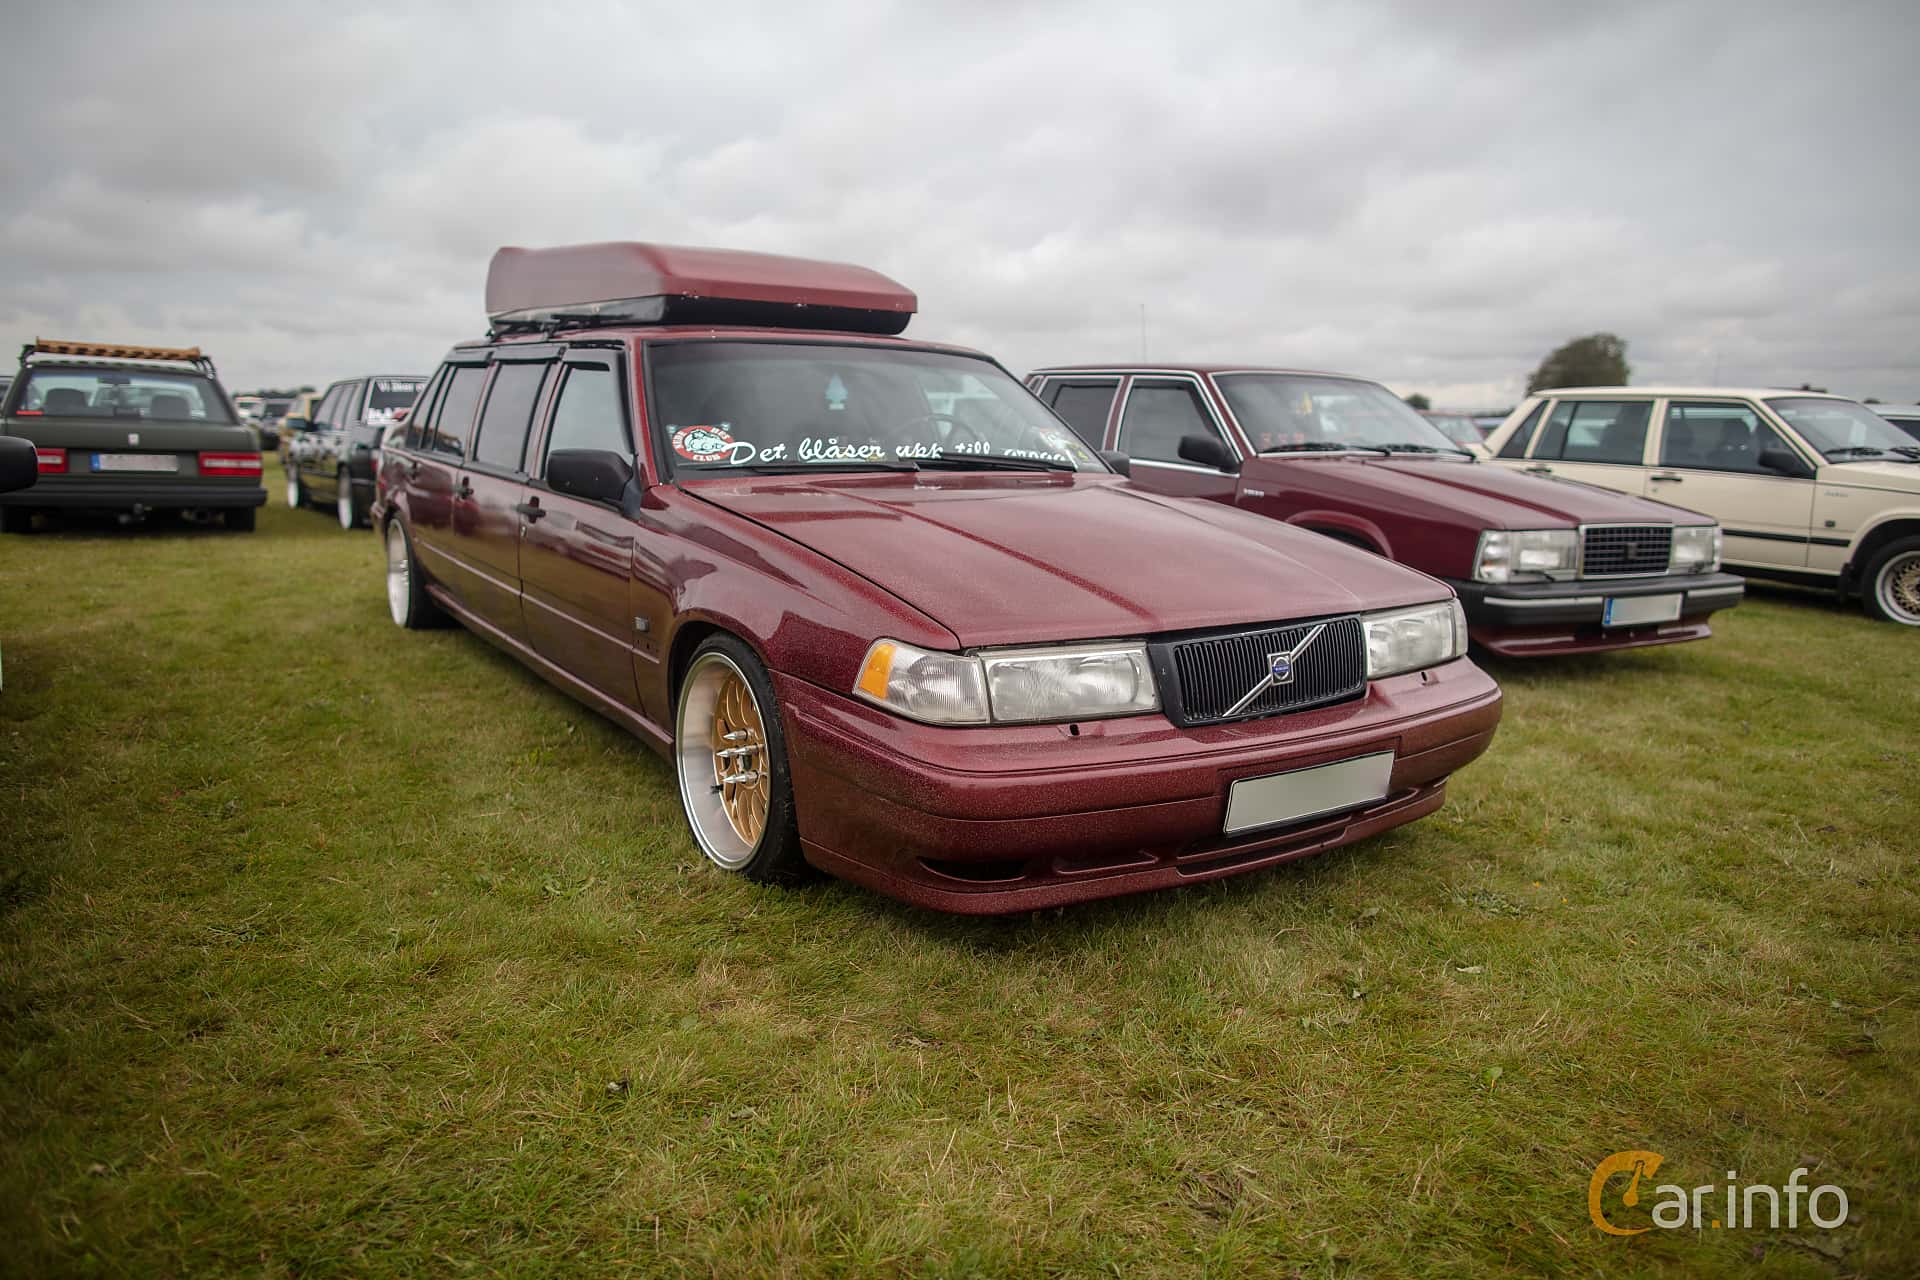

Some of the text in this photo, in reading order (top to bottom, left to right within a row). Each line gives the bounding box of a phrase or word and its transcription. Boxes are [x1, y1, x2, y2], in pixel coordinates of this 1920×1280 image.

[692, 453, 721, 462] CLUB
[720, 441, 788, 465] Det
[798, 437, 886, 460] blåser
